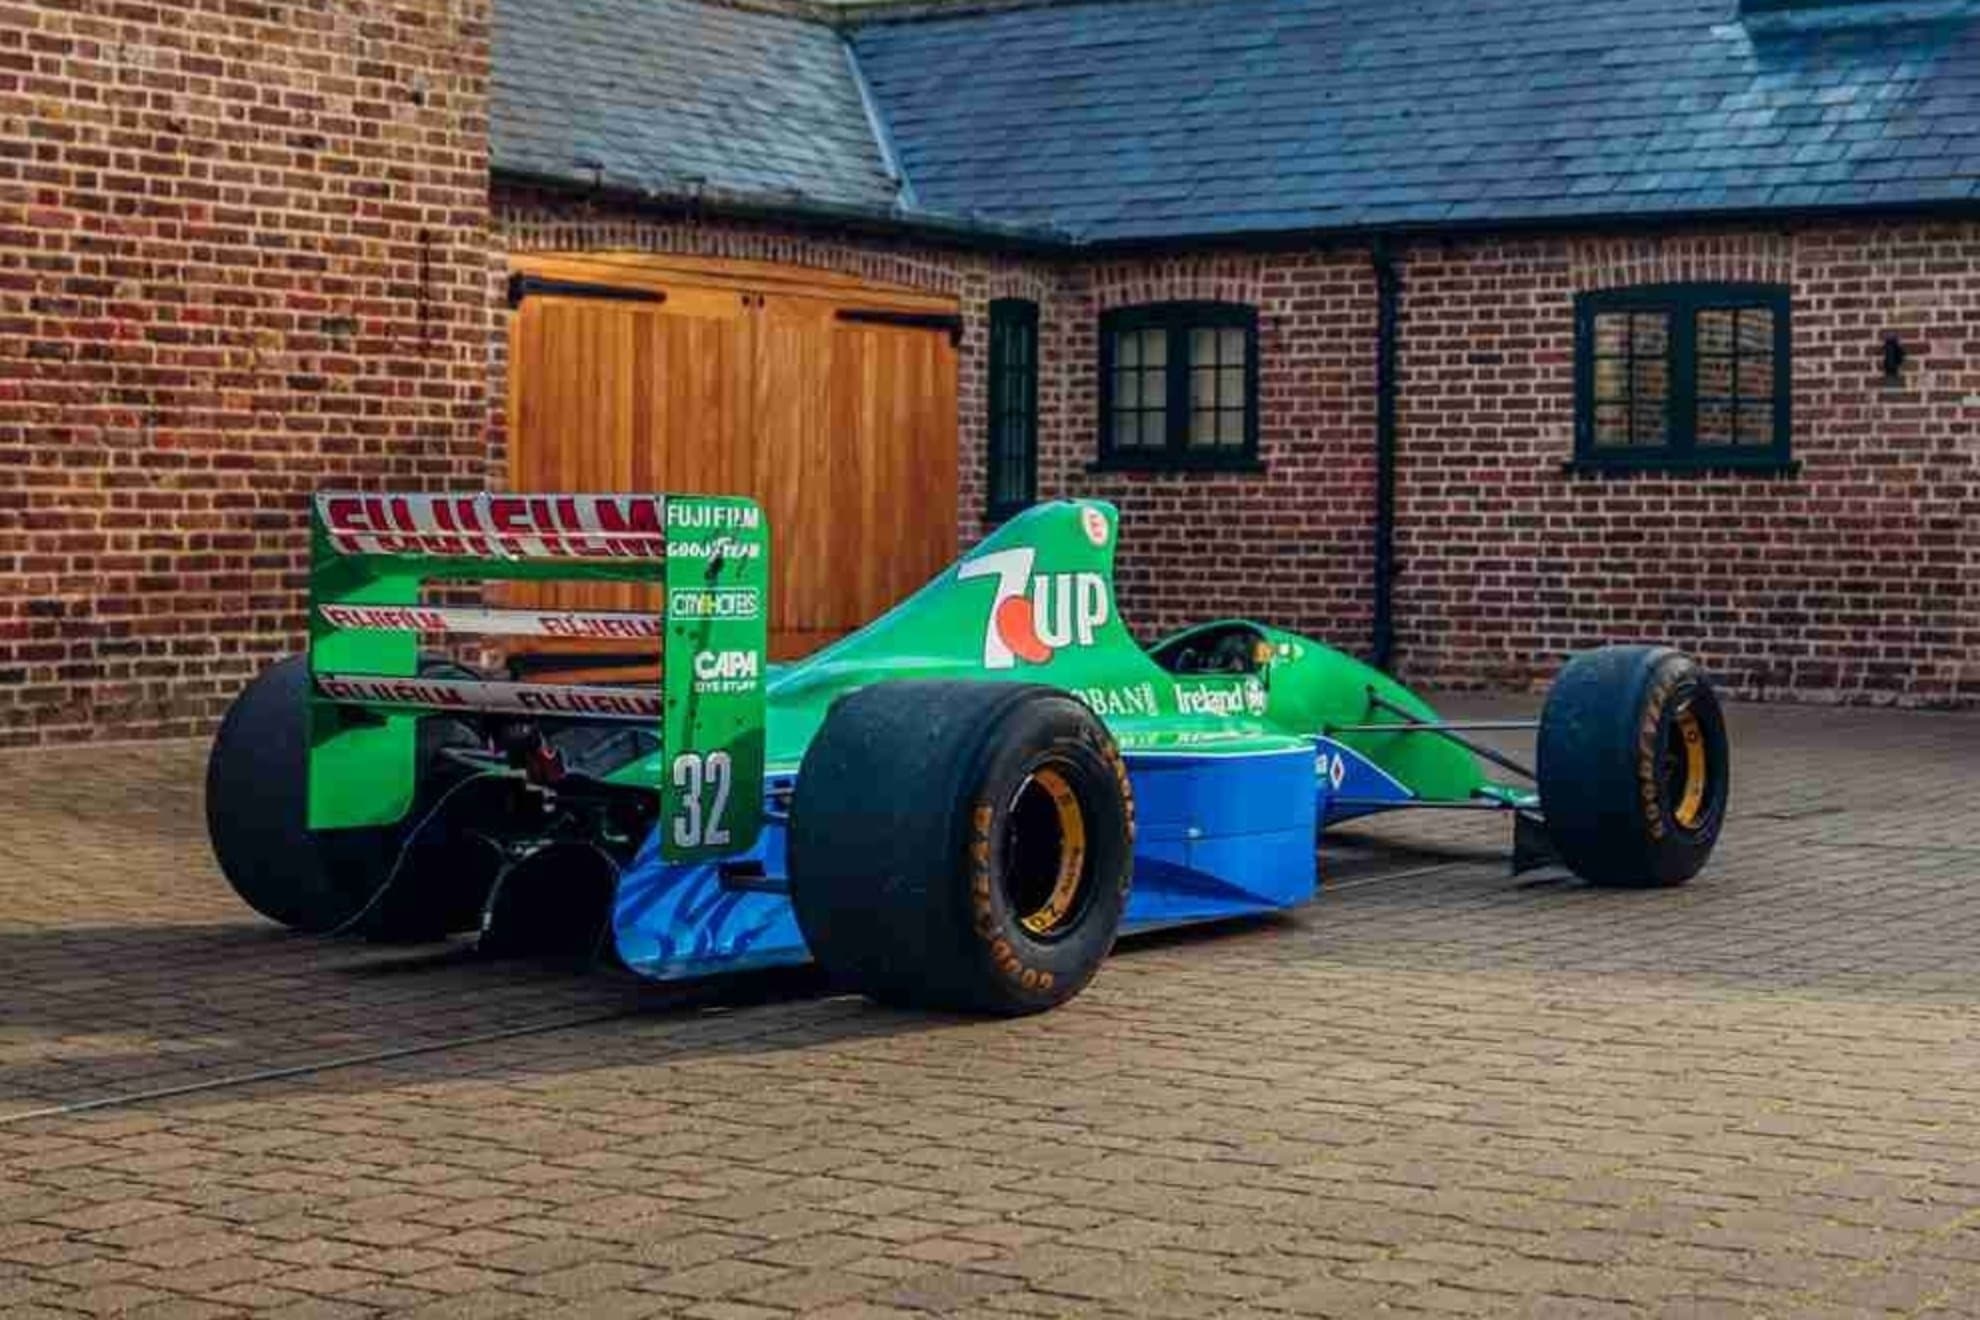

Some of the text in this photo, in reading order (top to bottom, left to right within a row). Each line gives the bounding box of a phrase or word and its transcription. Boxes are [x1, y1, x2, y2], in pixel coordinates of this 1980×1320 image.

[328, 497, 668, 556] FUJIFILM
[667, 505, 759, 528] FUJIFILM
[323, 607, 448, 632] FUJIFILM
[1174, 682, 1244, 717] Ireland
[673, 752, 731, 847] 32
